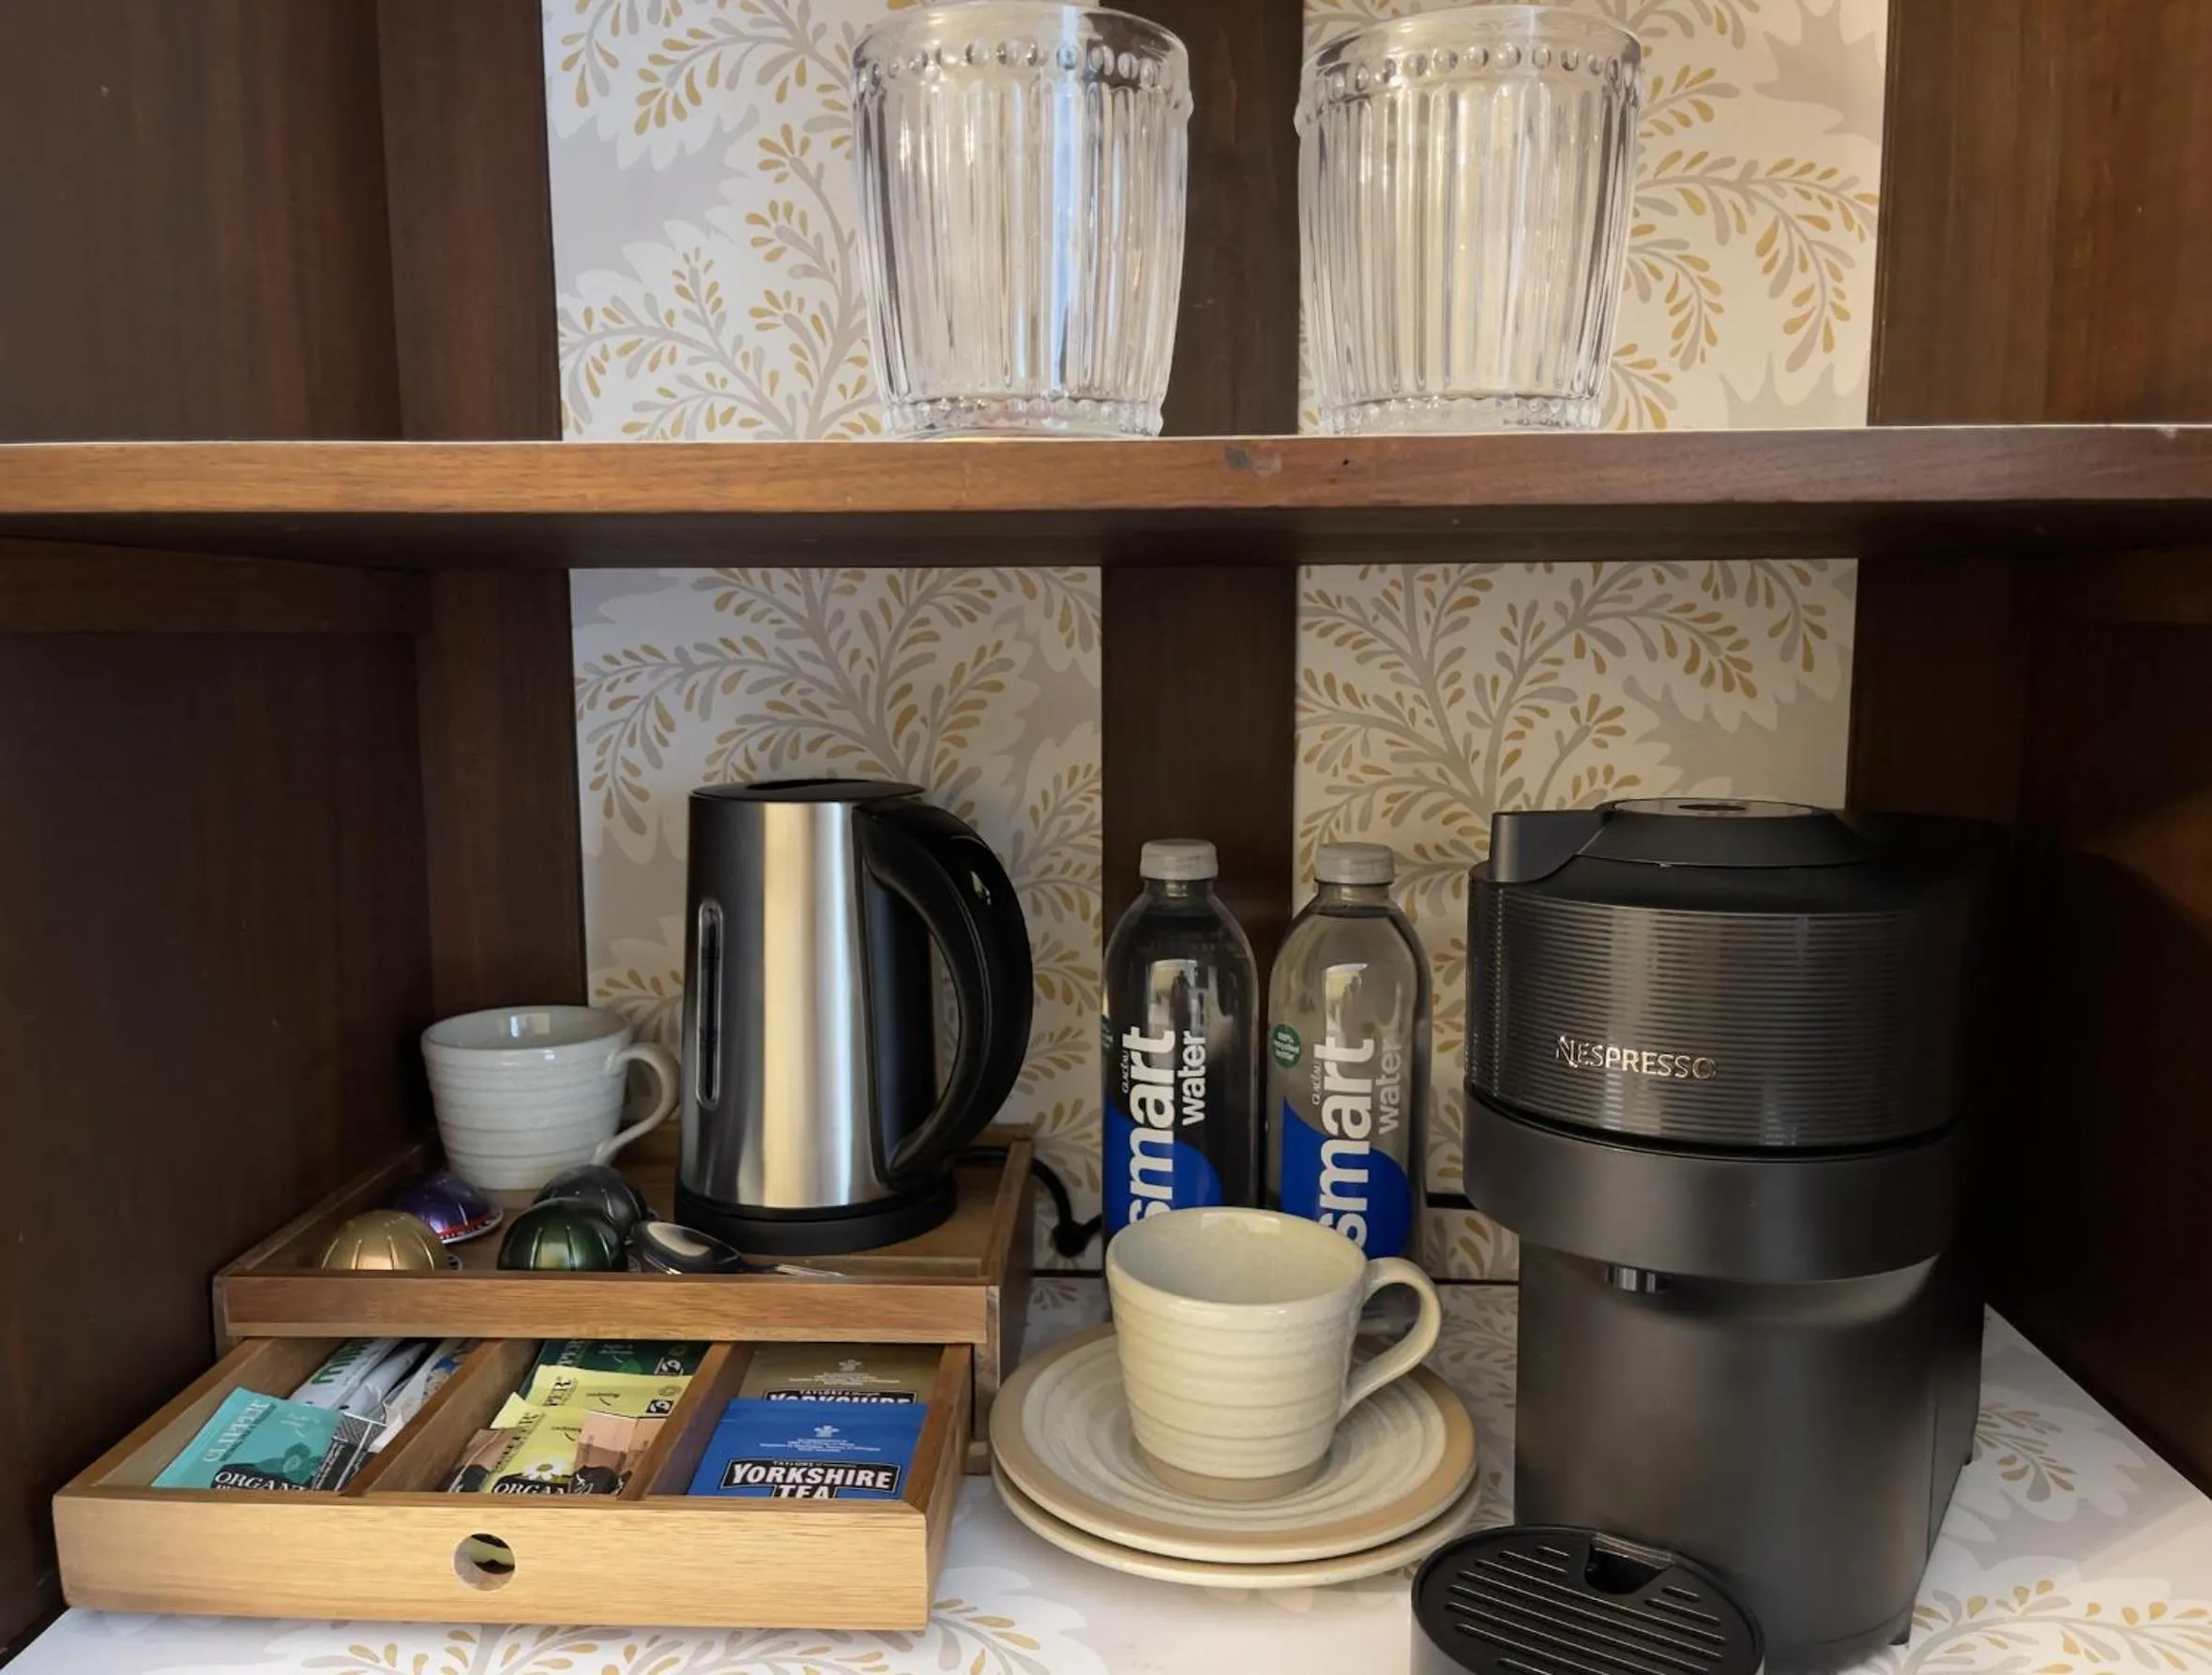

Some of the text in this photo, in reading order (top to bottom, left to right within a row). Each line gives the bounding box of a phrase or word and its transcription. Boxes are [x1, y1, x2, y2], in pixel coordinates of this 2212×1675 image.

[1178, 1031, 1207, 1125] water
[1375, 1037, 1401, 1134] water
[1555, 1035, 1716, 1081] NESPRESSO
[1313, 1036, 1375, 1246] smart
[733, 1463, 893, 1489] YORKSHIRE
[779, 1485, 829, 1499] TEA
